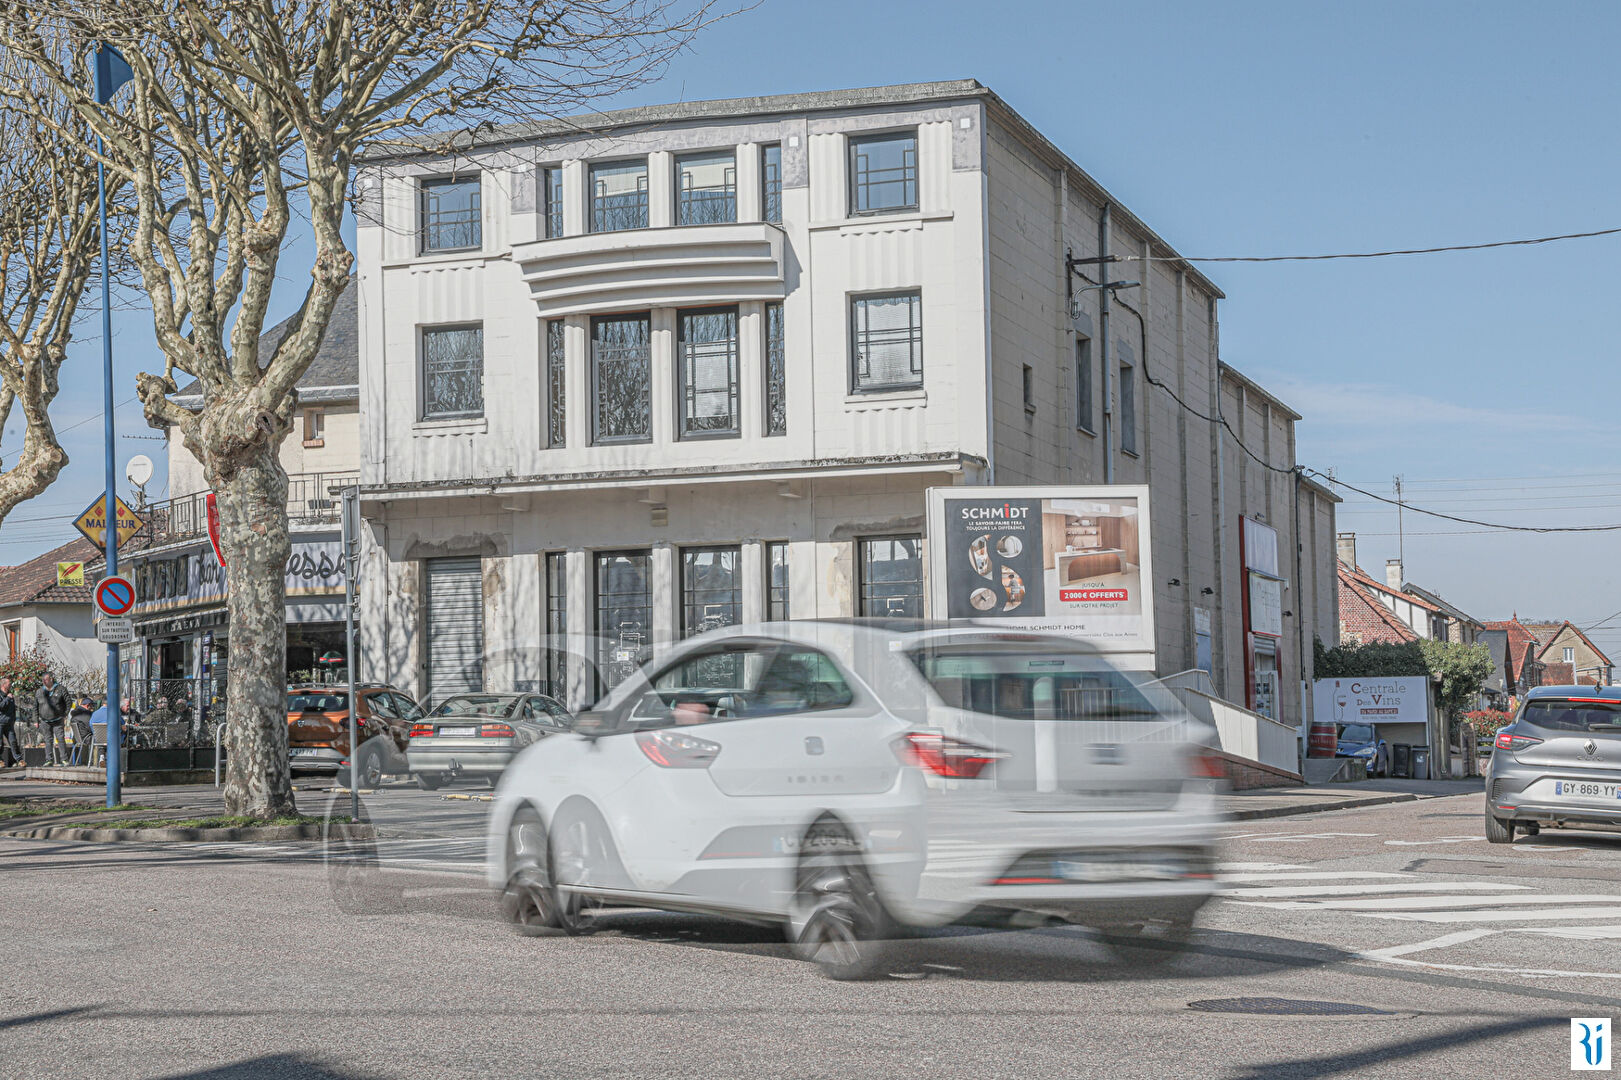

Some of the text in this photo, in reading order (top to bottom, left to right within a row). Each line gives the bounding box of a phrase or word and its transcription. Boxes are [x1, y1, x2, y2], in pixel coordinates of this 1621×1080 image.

[1351, 681, 1406, 694] Centrale
[1371, 694, 1401, 706] Vins
[1563, 783, 1616, 796] GY-869-YY
